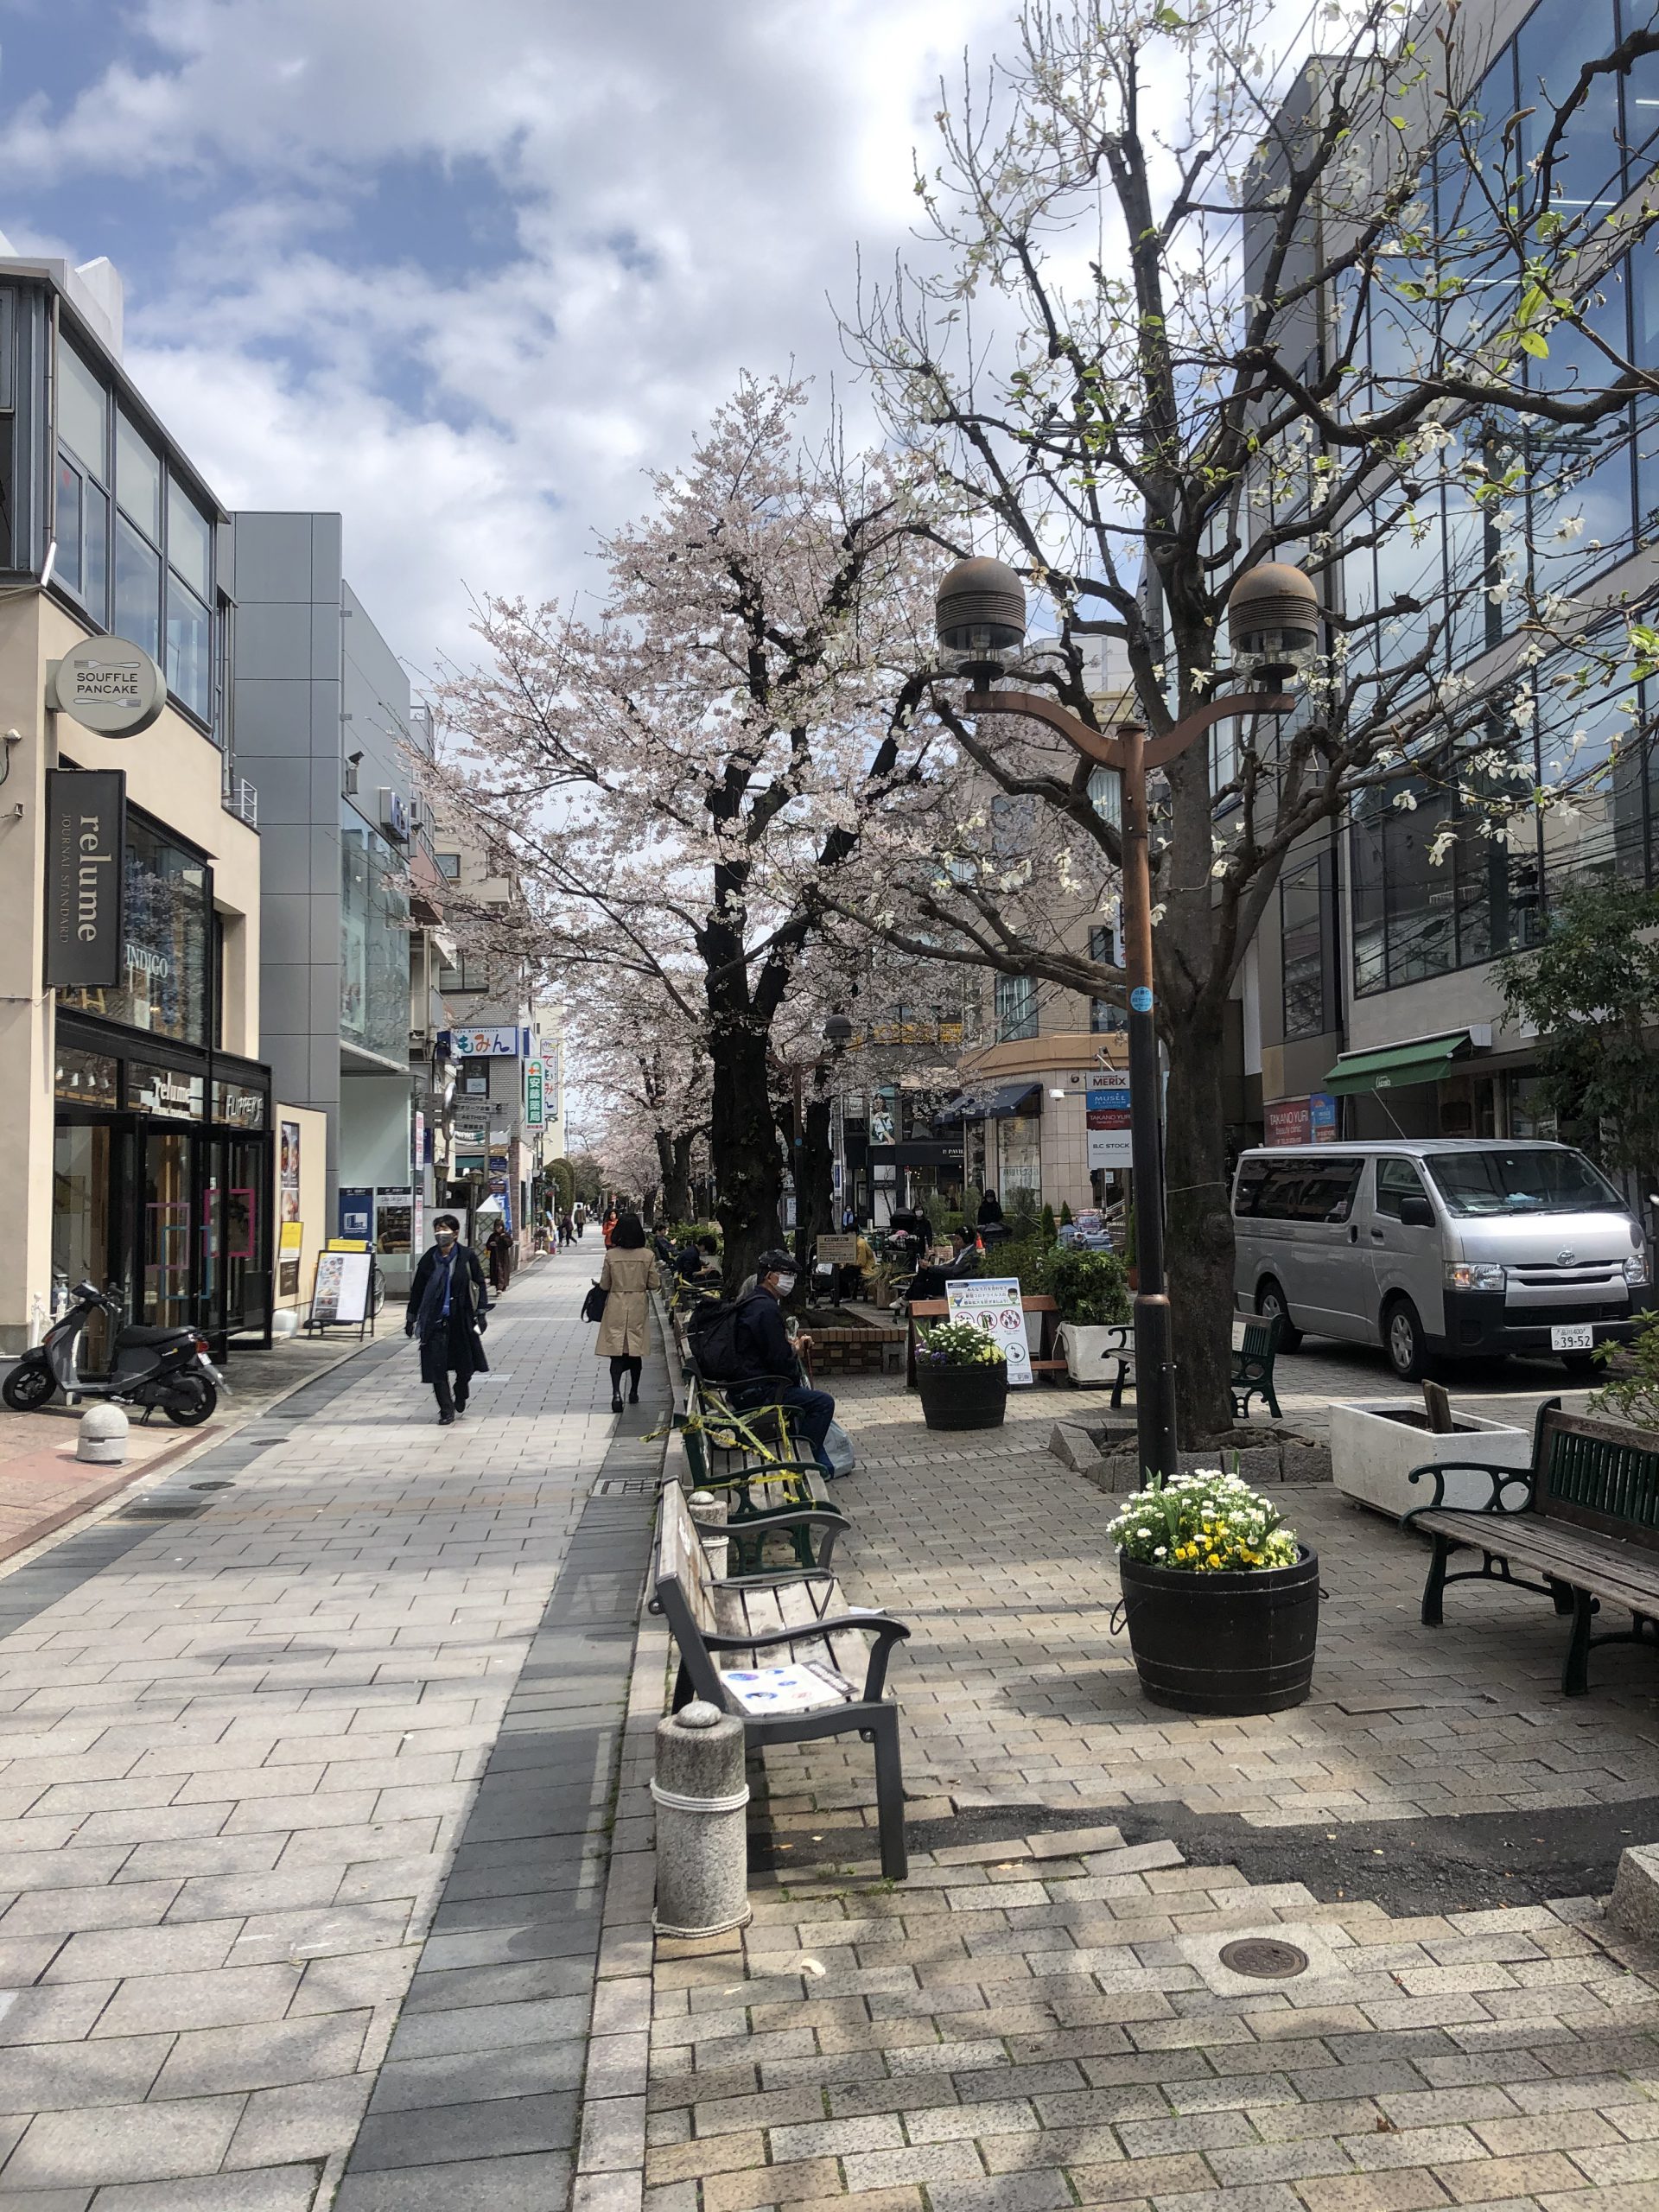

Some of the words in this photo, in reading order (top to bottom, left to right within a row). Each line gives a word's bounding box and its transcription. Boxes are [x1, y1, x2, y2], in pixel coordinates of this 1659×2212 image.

[76, 672, 138, 683] SOUFFLE
[76, 684, 138, 694] PANCAKE
[77, 815, 112, 942] relume
[59, 874, 70, 943] STANDARD
[126, 944, 168, 978] INDIGO
[1092, 1077, 1127, 1086] MERIX
[529, 1077, 541, 1122] 安藤薬局
[1560, 1335, 1591, 1348] 39-52
